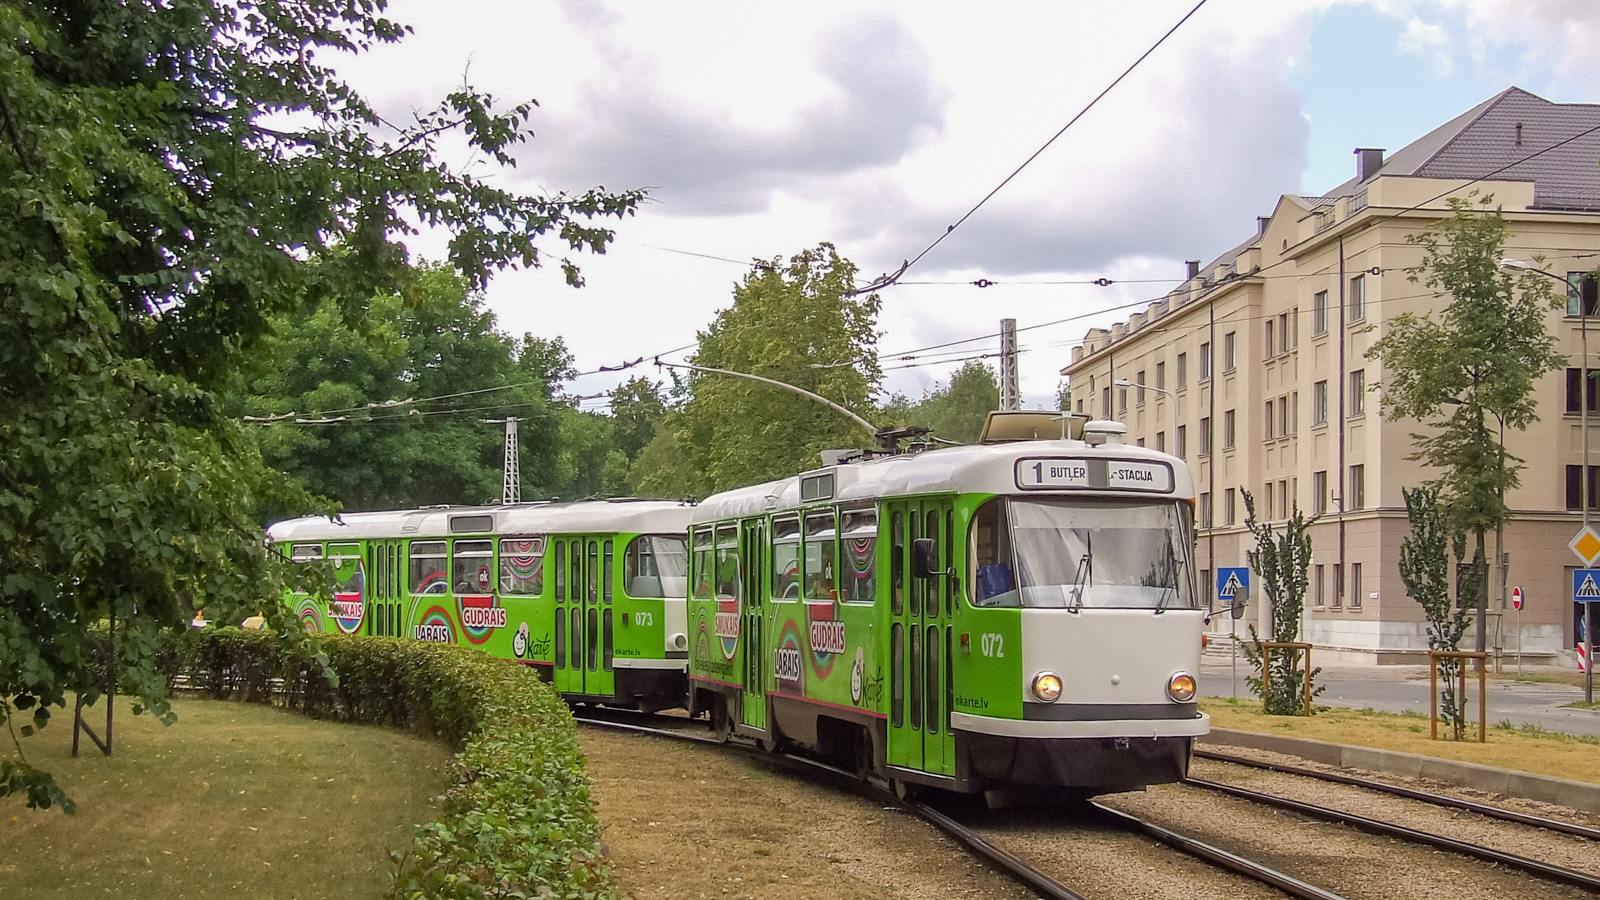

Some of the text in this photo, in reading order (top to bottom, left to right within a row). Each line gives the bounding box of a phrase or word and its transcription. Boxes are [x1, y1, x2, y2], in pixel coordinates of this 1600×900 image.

[1032, 462, 1043, 483] 1
[479, 570, 489, 582] ok
[462, 608, 506, 627] GUDRAIS
[635, 612, 653, 626] 073
[415, 626, 447, 642] LABAIS
[811, 624, 845, 651] GUDRAIS
[981, 632, 1005, 658] 072
[774, 650, 799, 679] LABAIS
[955, 694, 989, 709] okarte.lv
